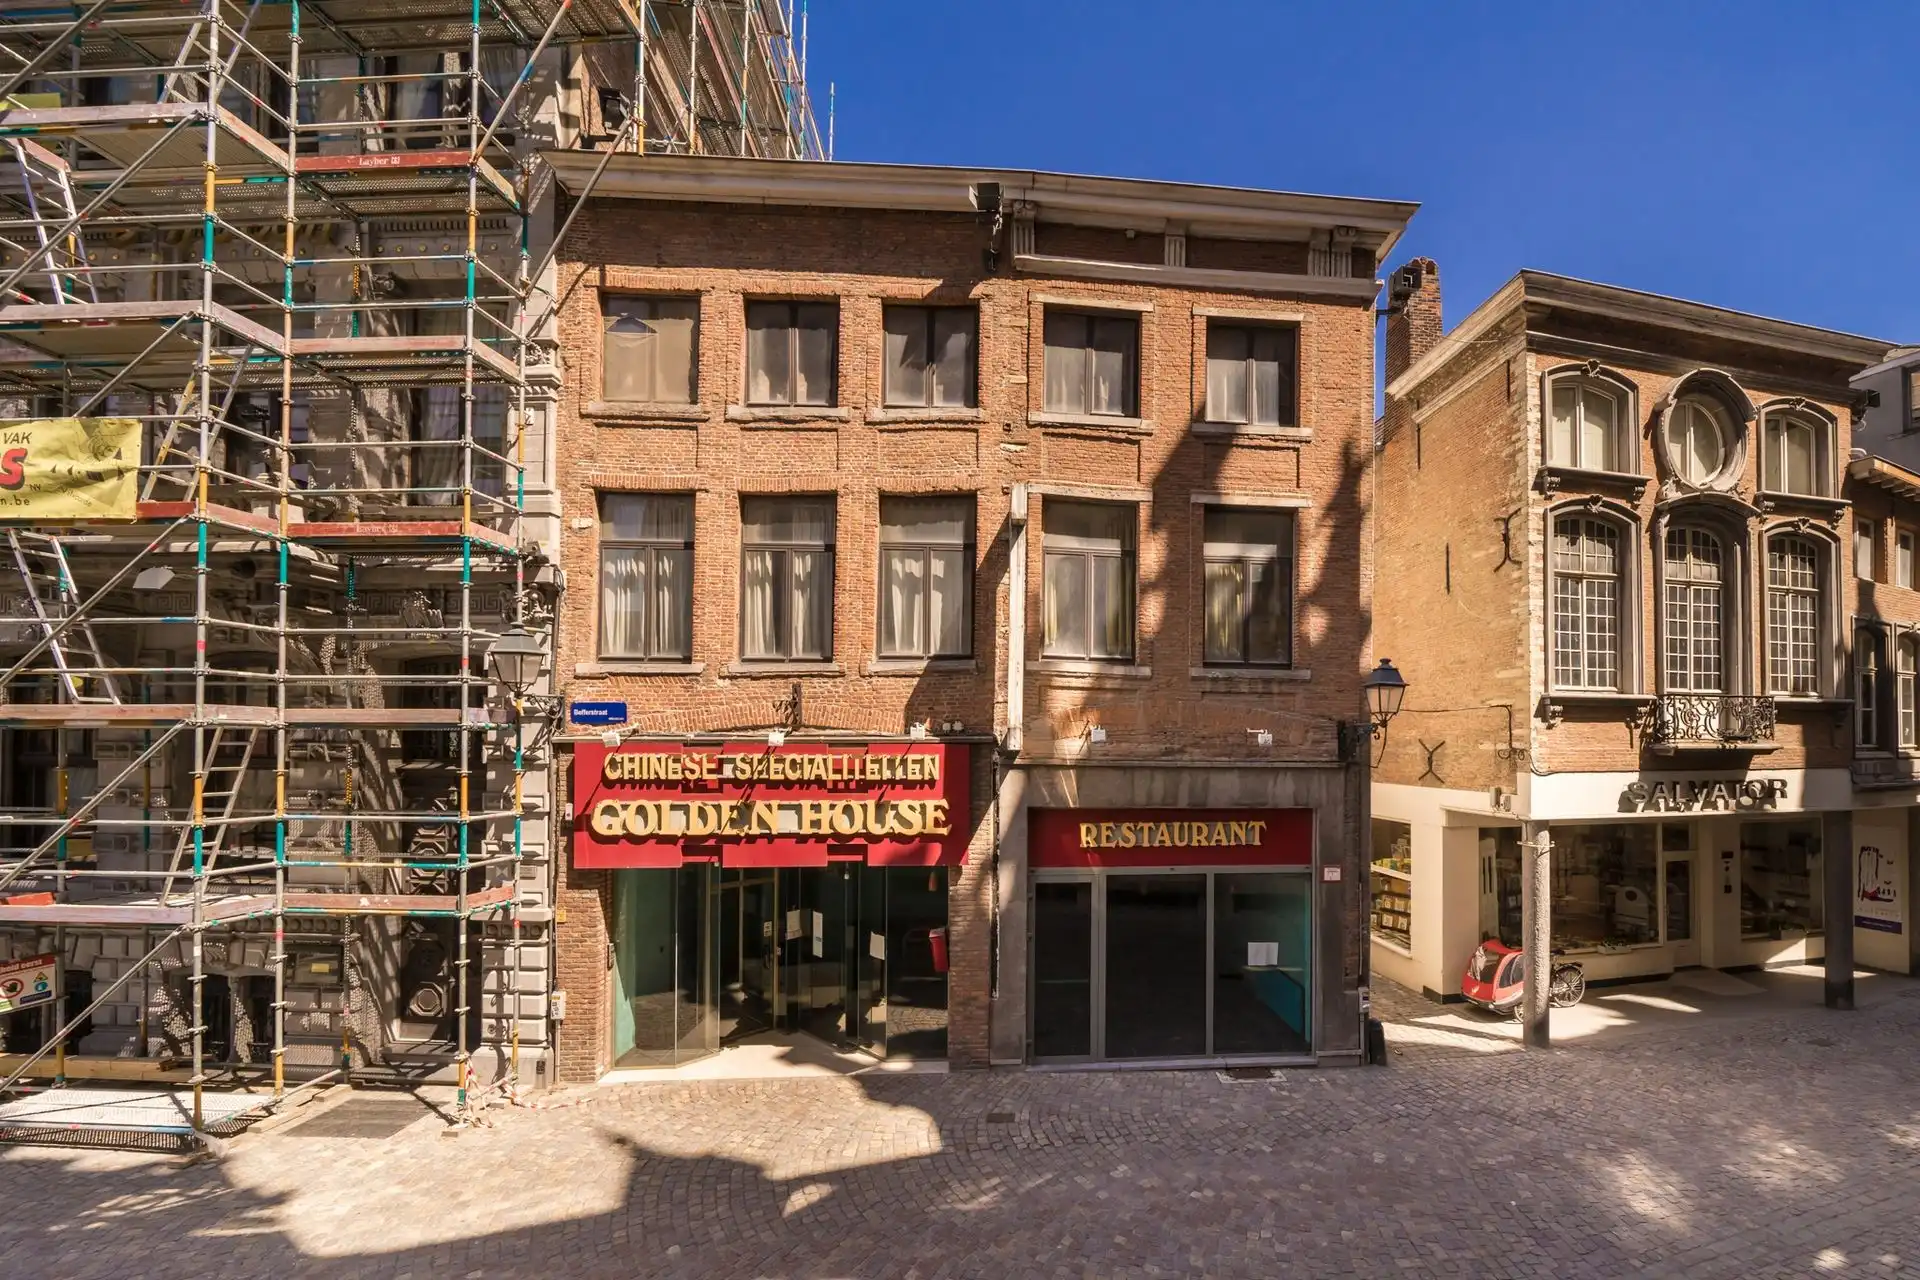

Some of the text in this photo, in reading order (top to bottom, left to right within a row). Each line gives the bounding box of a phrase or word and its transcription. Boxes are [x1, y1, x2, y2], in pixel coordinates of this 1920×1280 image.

[359, 156, 389, 166] Layher
[3, 432, 32, 444] VAK
[604, 753, 717, 780] CHINESE
[1627, 779, 1788, 804] SALVATOR
[591, 798, 952, 836] GOLDEN HOUSE
[1079, 820, 1267, 849] RESTAURANT
